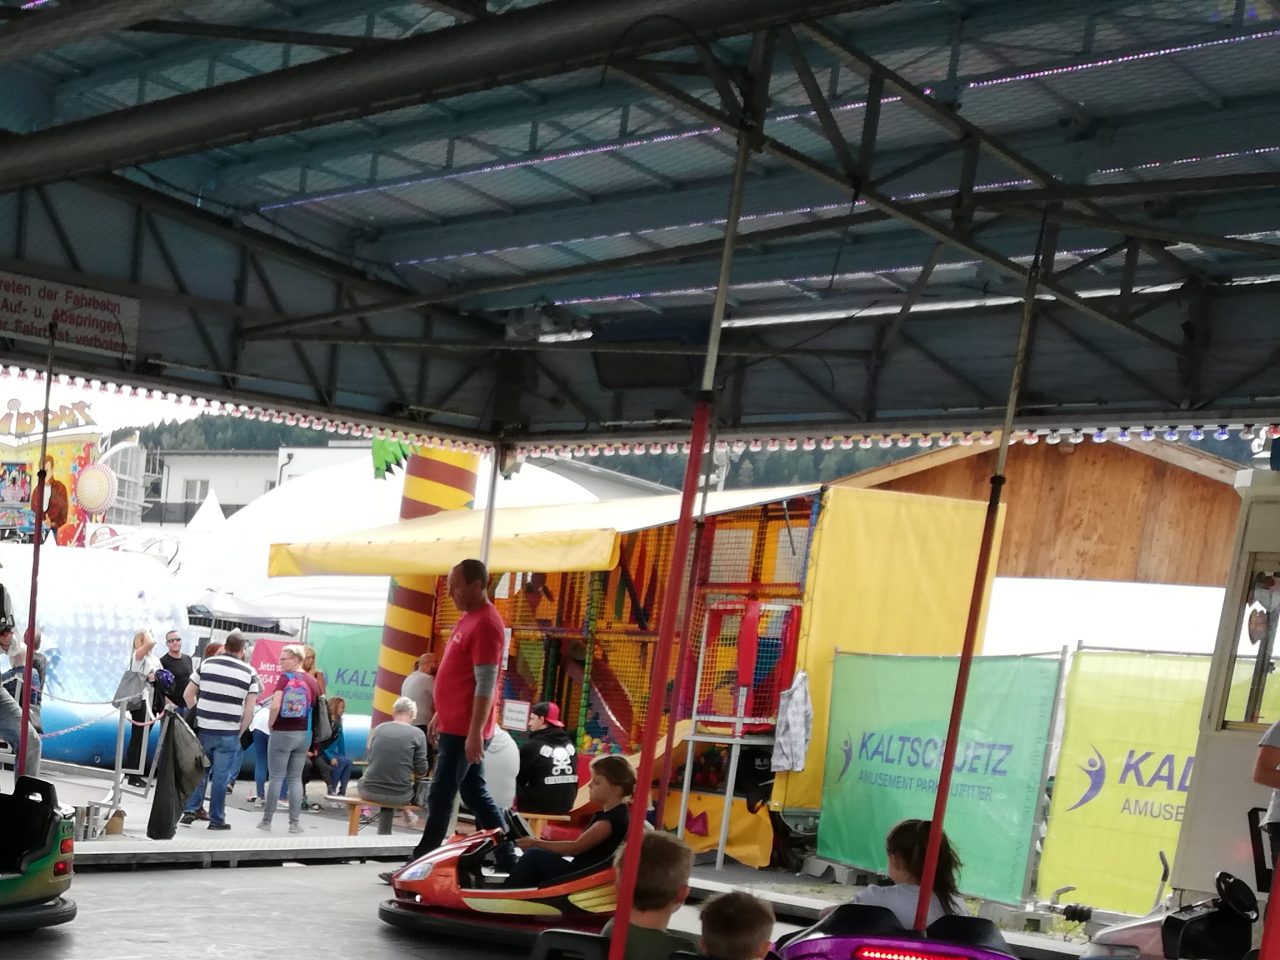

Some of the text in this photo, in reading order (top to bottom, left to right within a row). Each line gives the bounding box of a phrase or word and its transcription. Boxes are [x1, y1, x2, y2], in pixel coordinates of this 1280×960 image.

[1, 297, 27, 315] Auf-
[34, 306, 45, 319] u.
[52, 307, 122, 334] Abspringen
[38, 285, 60, 301] der
[65, 290, 121, 315] Fahrbahn
[75, 334, 129, 353] verboten
[858, 769, 915, 791] AMUSEMENT
[950, 783, 993, 801] UTFITTER
[1118, 749, 1196, 793] KAL
[1120, 797, 1186, 822] AMUSE
